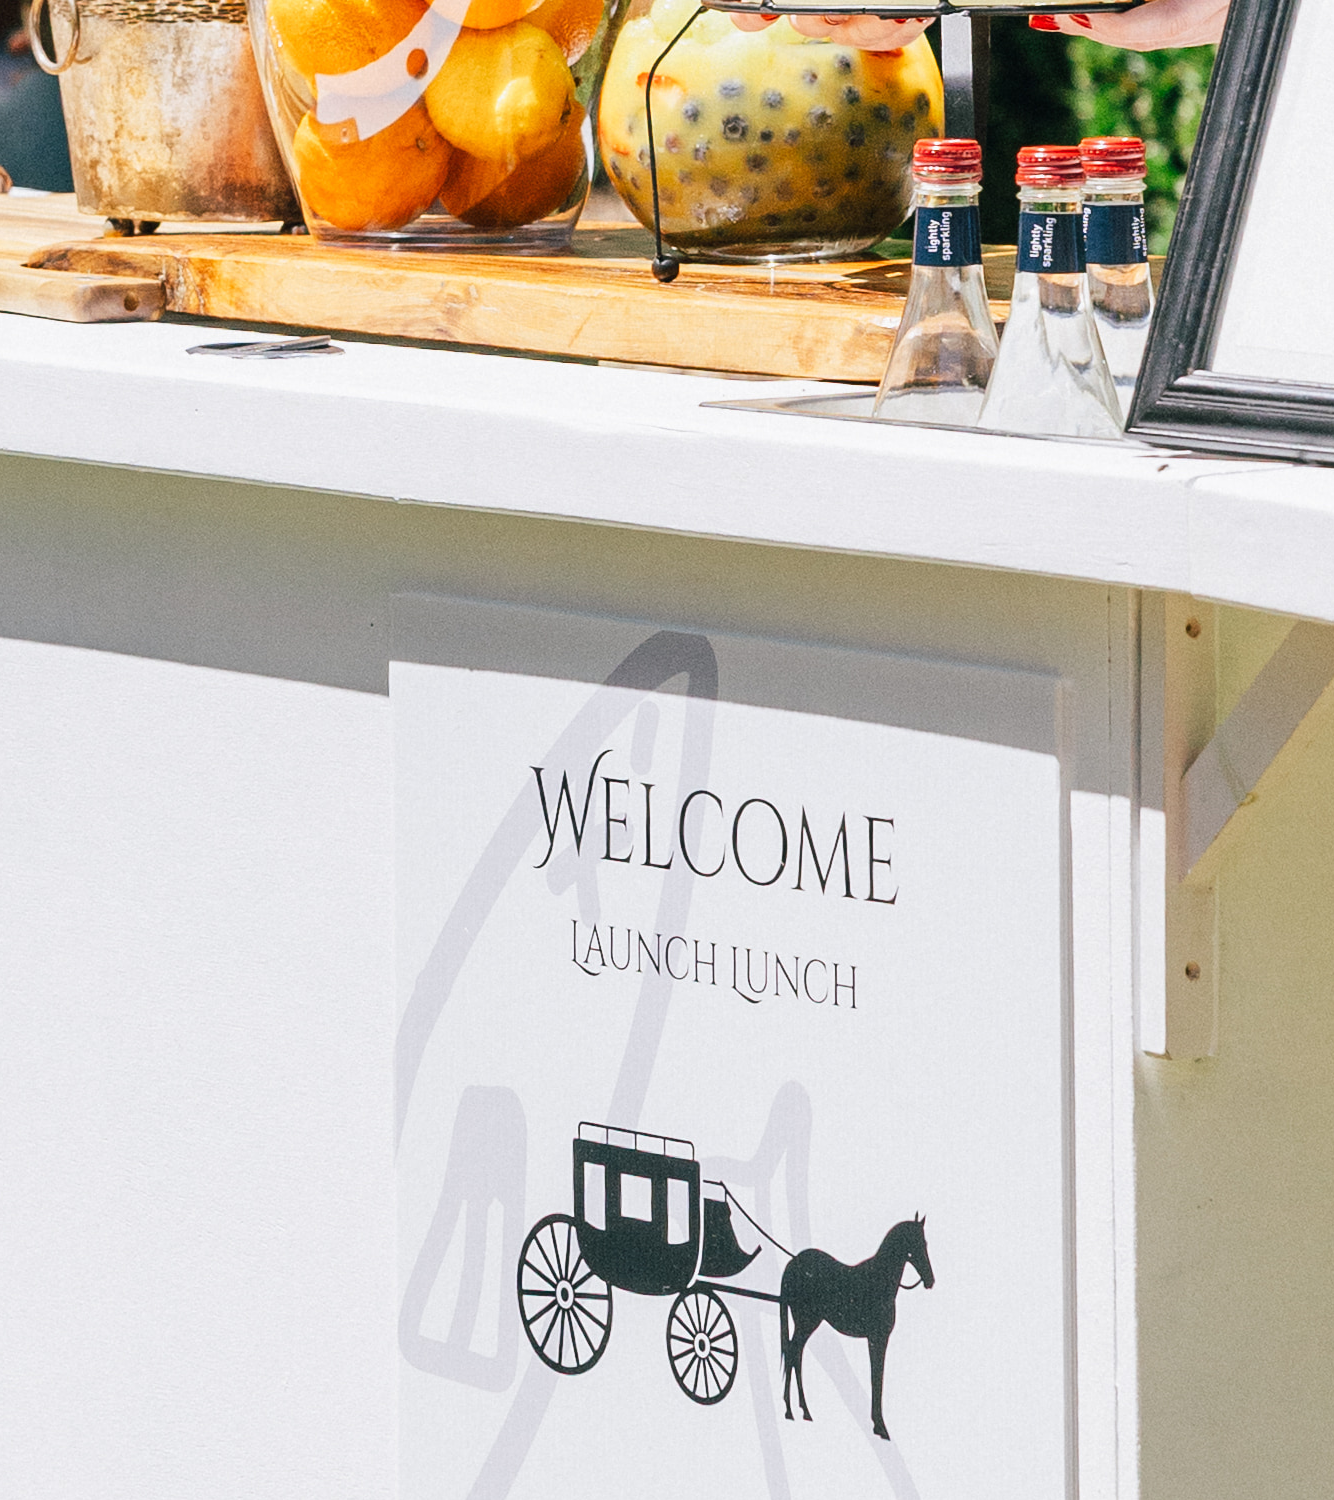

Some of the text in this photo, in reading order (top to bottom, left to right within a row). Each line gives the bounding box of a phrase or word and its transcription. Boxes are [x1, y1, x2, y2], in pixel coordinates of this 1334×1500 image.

[927, 219, 941, 253] lightly
[942, 211, 953, 261] sparkling
[1029, 223, 1043, 258] lightly
[1042, 217, 1057, 268] sparkling
[529, 749, 899, 906] WELCOME
[571, 919, 858, 1010] LAUNCH LUNCH
